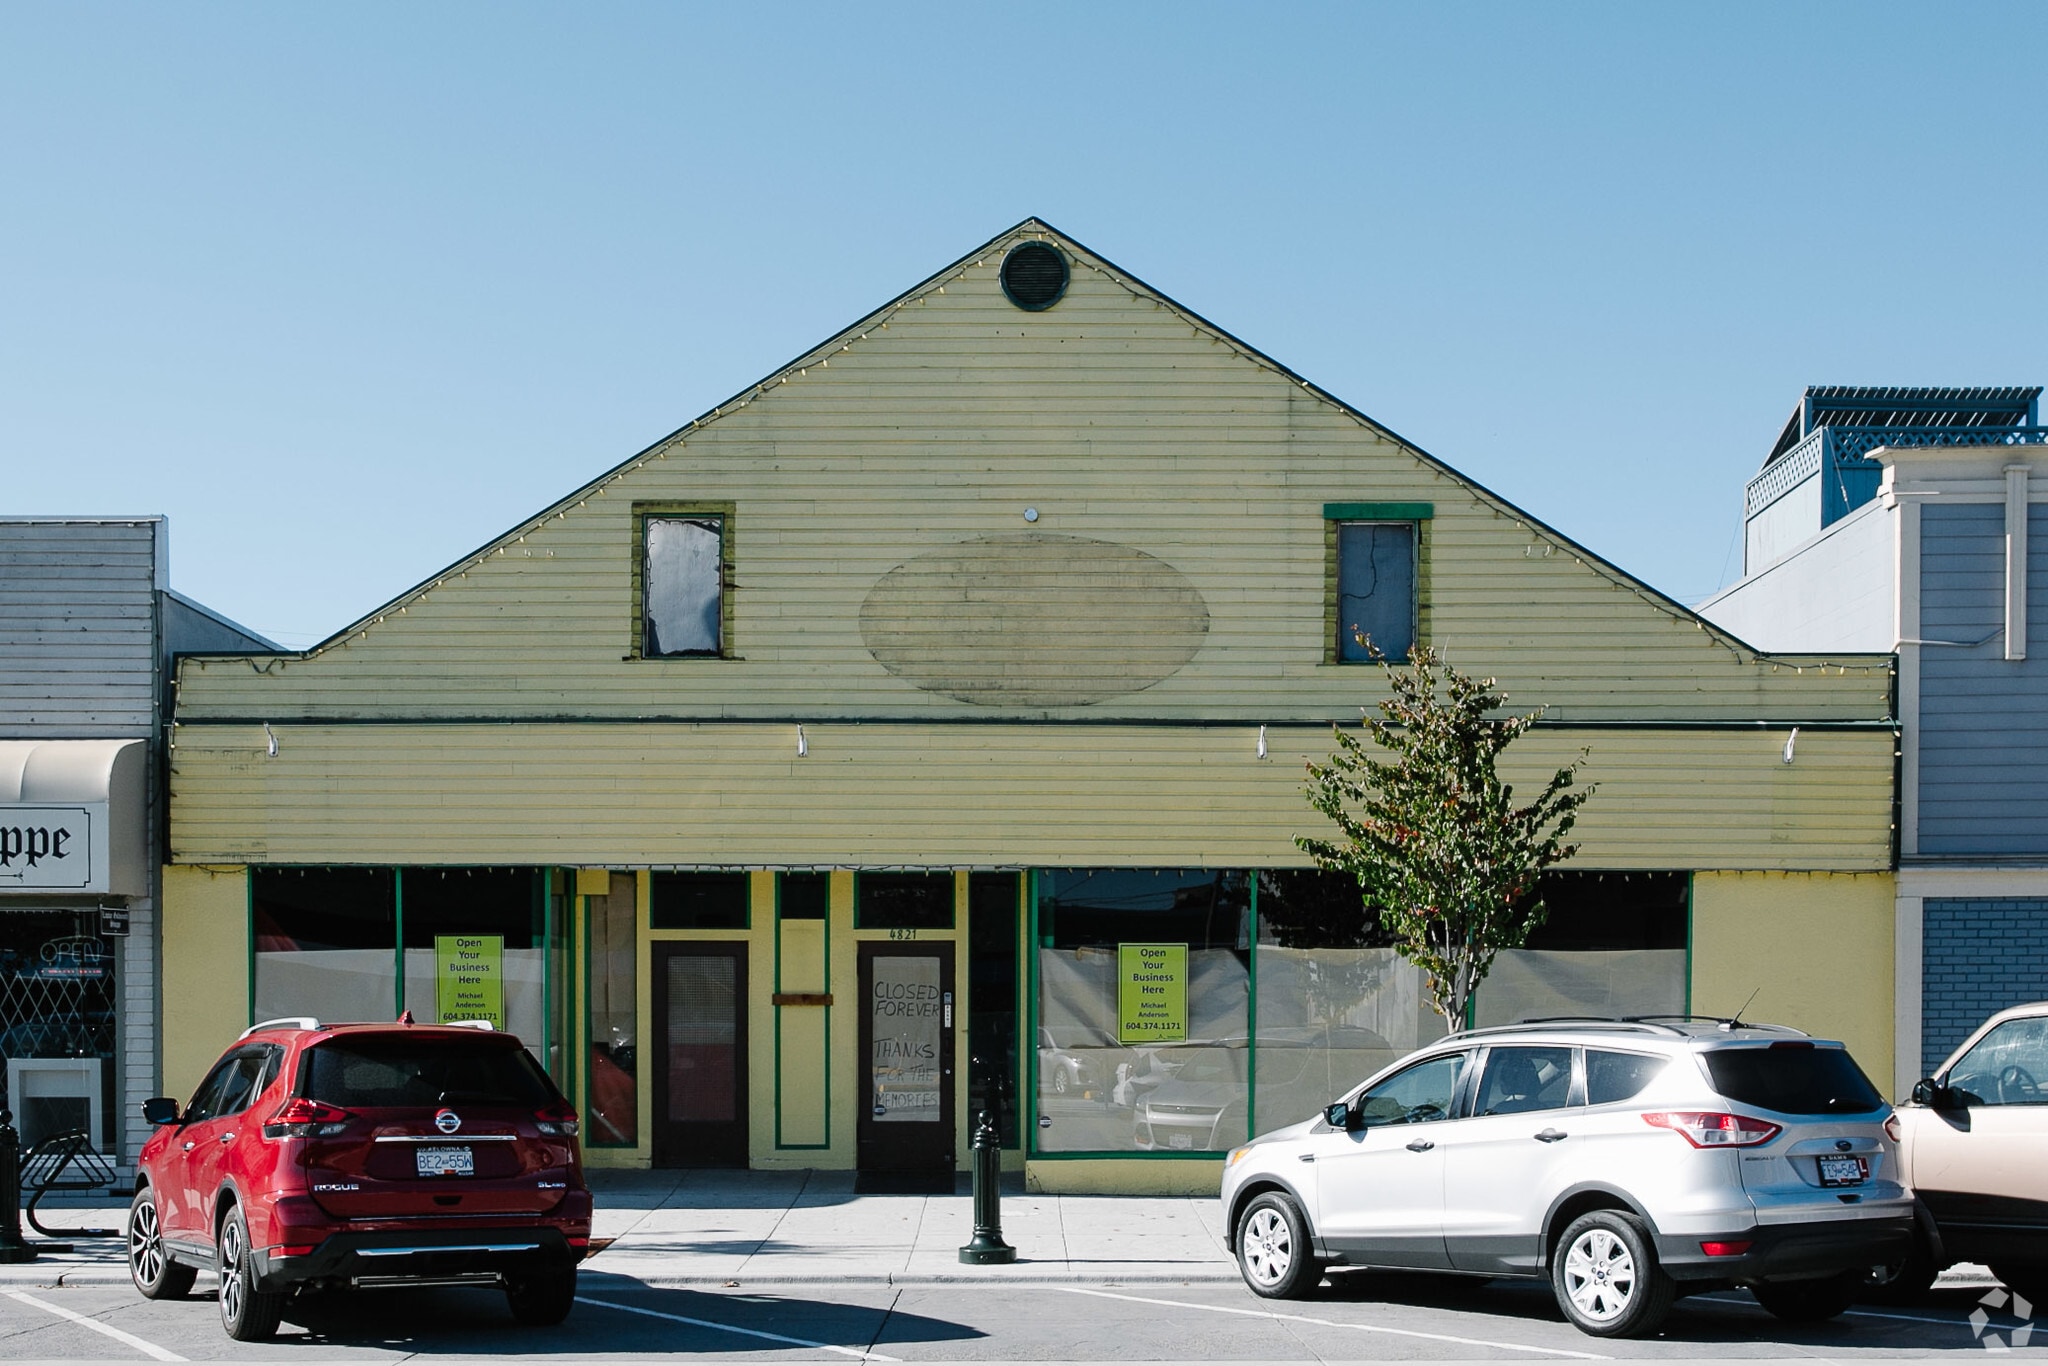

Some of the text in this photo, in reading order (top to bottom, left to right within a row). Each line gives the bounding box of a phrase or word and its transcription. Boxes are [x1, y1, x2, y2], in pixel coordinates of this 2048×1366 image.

[0, 826, 72, 868] ppe
[889, 928, 916, 940] 4821
[456, 938, 482, 948] Open
[40, 942, 100, 962] OPEN
[458, 950, 480, 959] Your
[1140, 948, 1166, 958] Open
[450, 963, 490, 972] Business
[1142, 961, 1164, 969] Your
[458, 976, 481, 984] Here
[1133, 973, 1174, 982] Business
[874, 981, 939, 1000] CLOSED
[1142, 985, 1165, 994] Here
[875, 1000, 939, 1017] FOREVER
[443, 1012, 497, 1021] 604.374.1171
[1125, 1022, 1181, 1030] 604.374.1171
[874, 1037, 935, 1059] THANKS
[875, 1064, 936, 1082] FOR THE
[875, 1093, 938, 1108] MEMORIES
